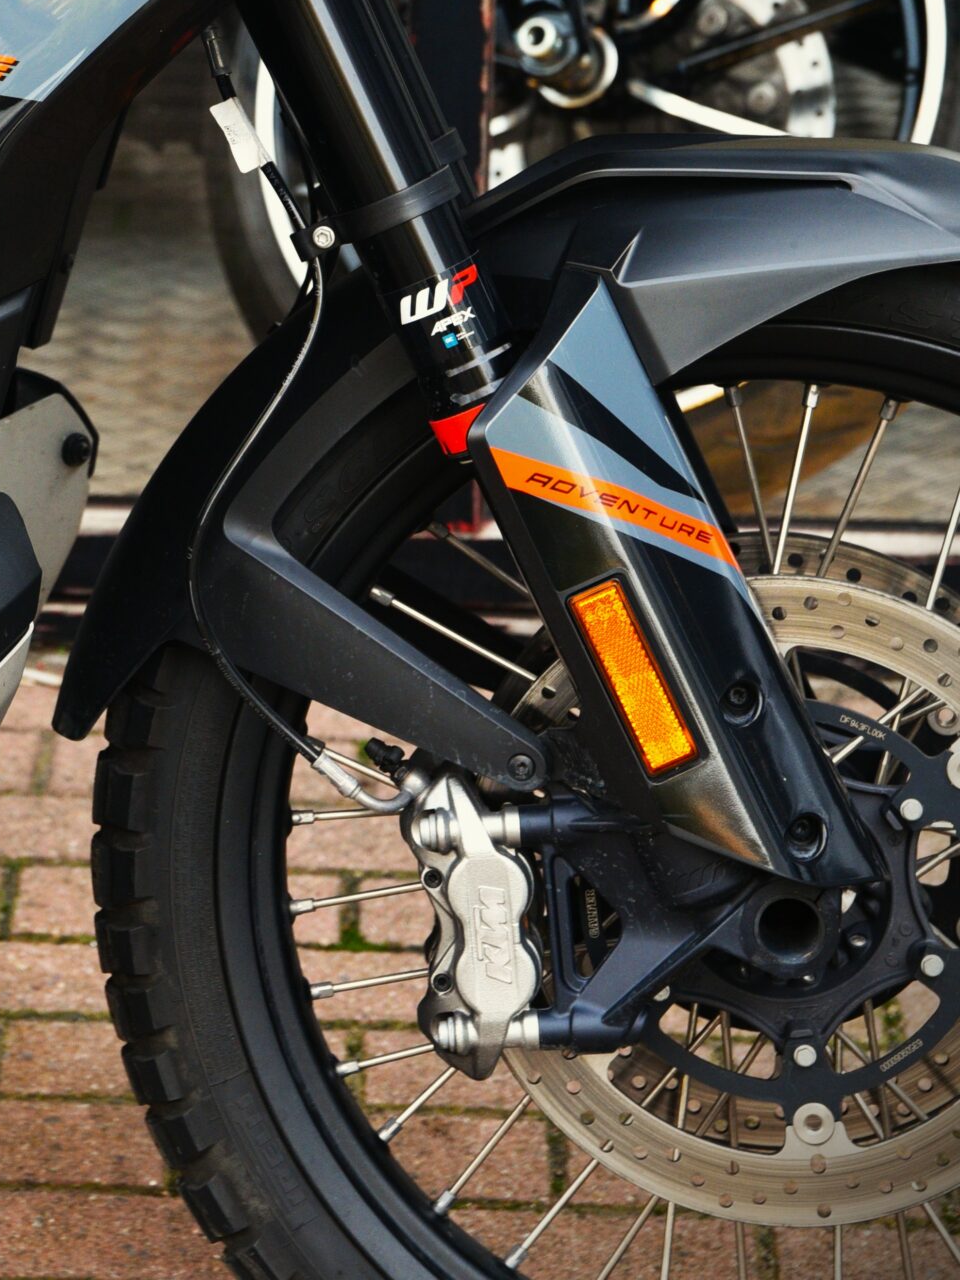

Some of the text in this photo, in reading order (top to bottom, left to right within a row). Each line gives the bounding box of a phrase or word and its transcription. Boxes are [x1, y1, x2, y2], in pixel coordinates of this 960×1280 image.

[400, 263, 479, 325] WP
[431, 306, 476, 336] APEX
[526, 472, 713, 544] ADVENTURE
[473, 886, 513, 984] KTM
